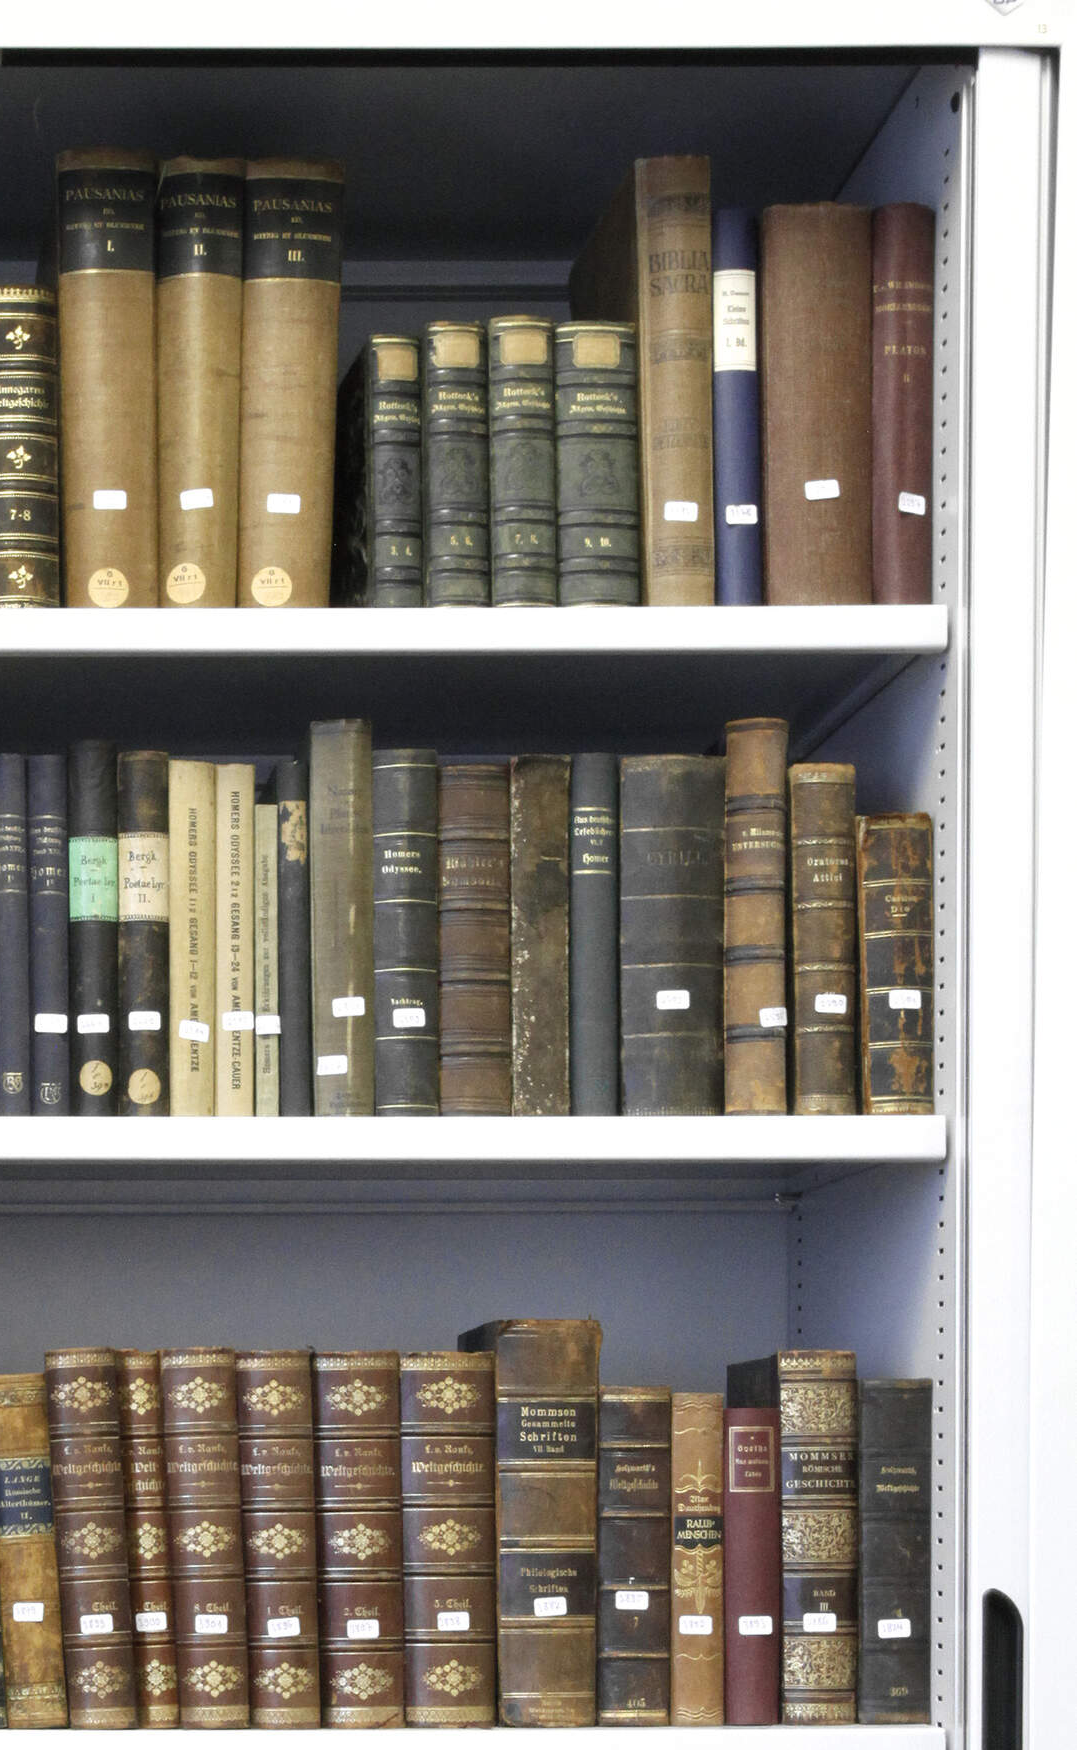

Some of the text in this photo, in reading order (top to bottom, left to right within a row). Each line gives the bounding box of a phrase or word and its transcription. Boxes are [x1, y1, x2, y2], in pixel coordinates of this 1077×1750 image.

[253, 199, 333, 215] PAUSANIAS
[188, 807, 198, 847] HOMERS
[231, 790, 240, 830] HOMERS
[128, 850, 157, 864] Bergk
[188, 850, 198, 894] ODYSSEE
[231, 834, 240, 877] ODYSSEE
[188, 917, 199, 956] GESANG
[231, 902, 240, 940] GESANG
[676, 1529, 722, 1542] MENSCHEN
